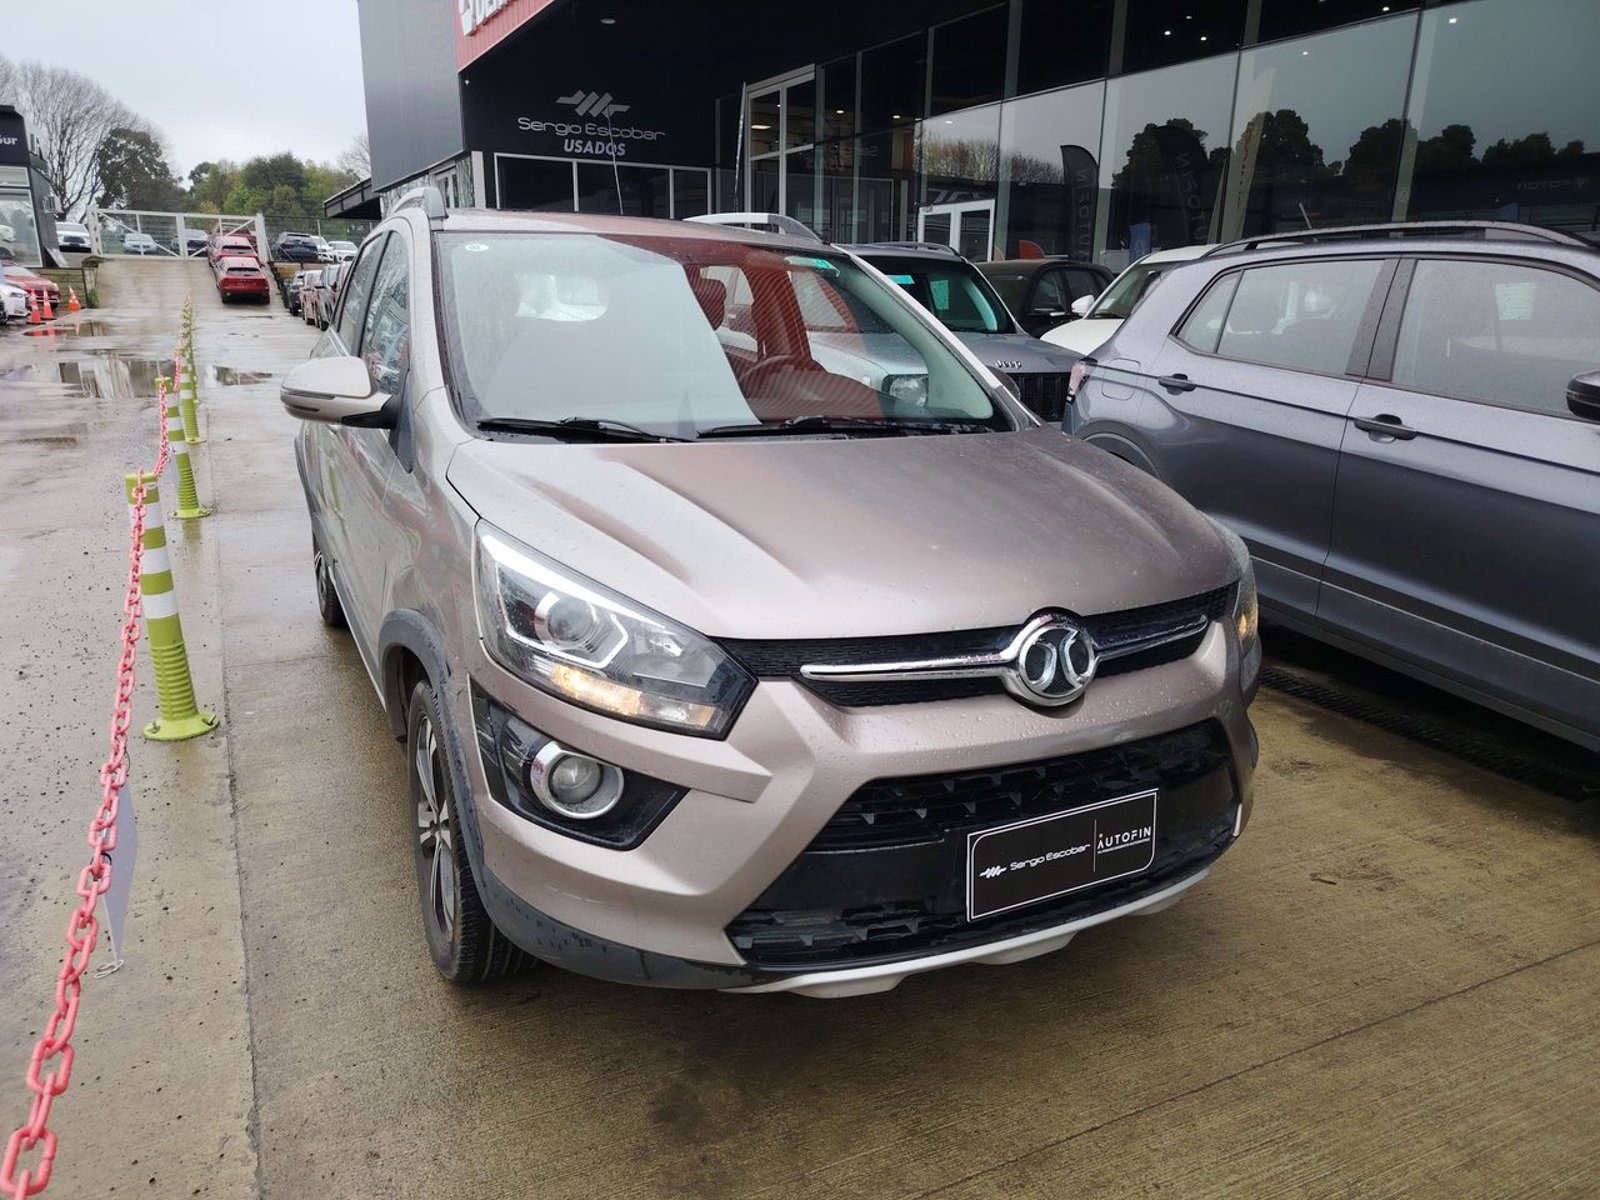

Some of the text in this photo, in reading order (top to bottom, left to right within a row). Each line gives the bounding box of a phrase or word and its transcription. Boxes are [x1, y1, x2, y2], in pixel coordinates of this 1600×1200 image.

[517, 117, 666, 141] Sergio Escobar
[564, 139, 626, 156] USADOS
[1096, 826, 1152, 850] AUTOFIN
[1010, 856, 1045, 870] Sergio
[1046, 844, 1091, 860] Escobar
